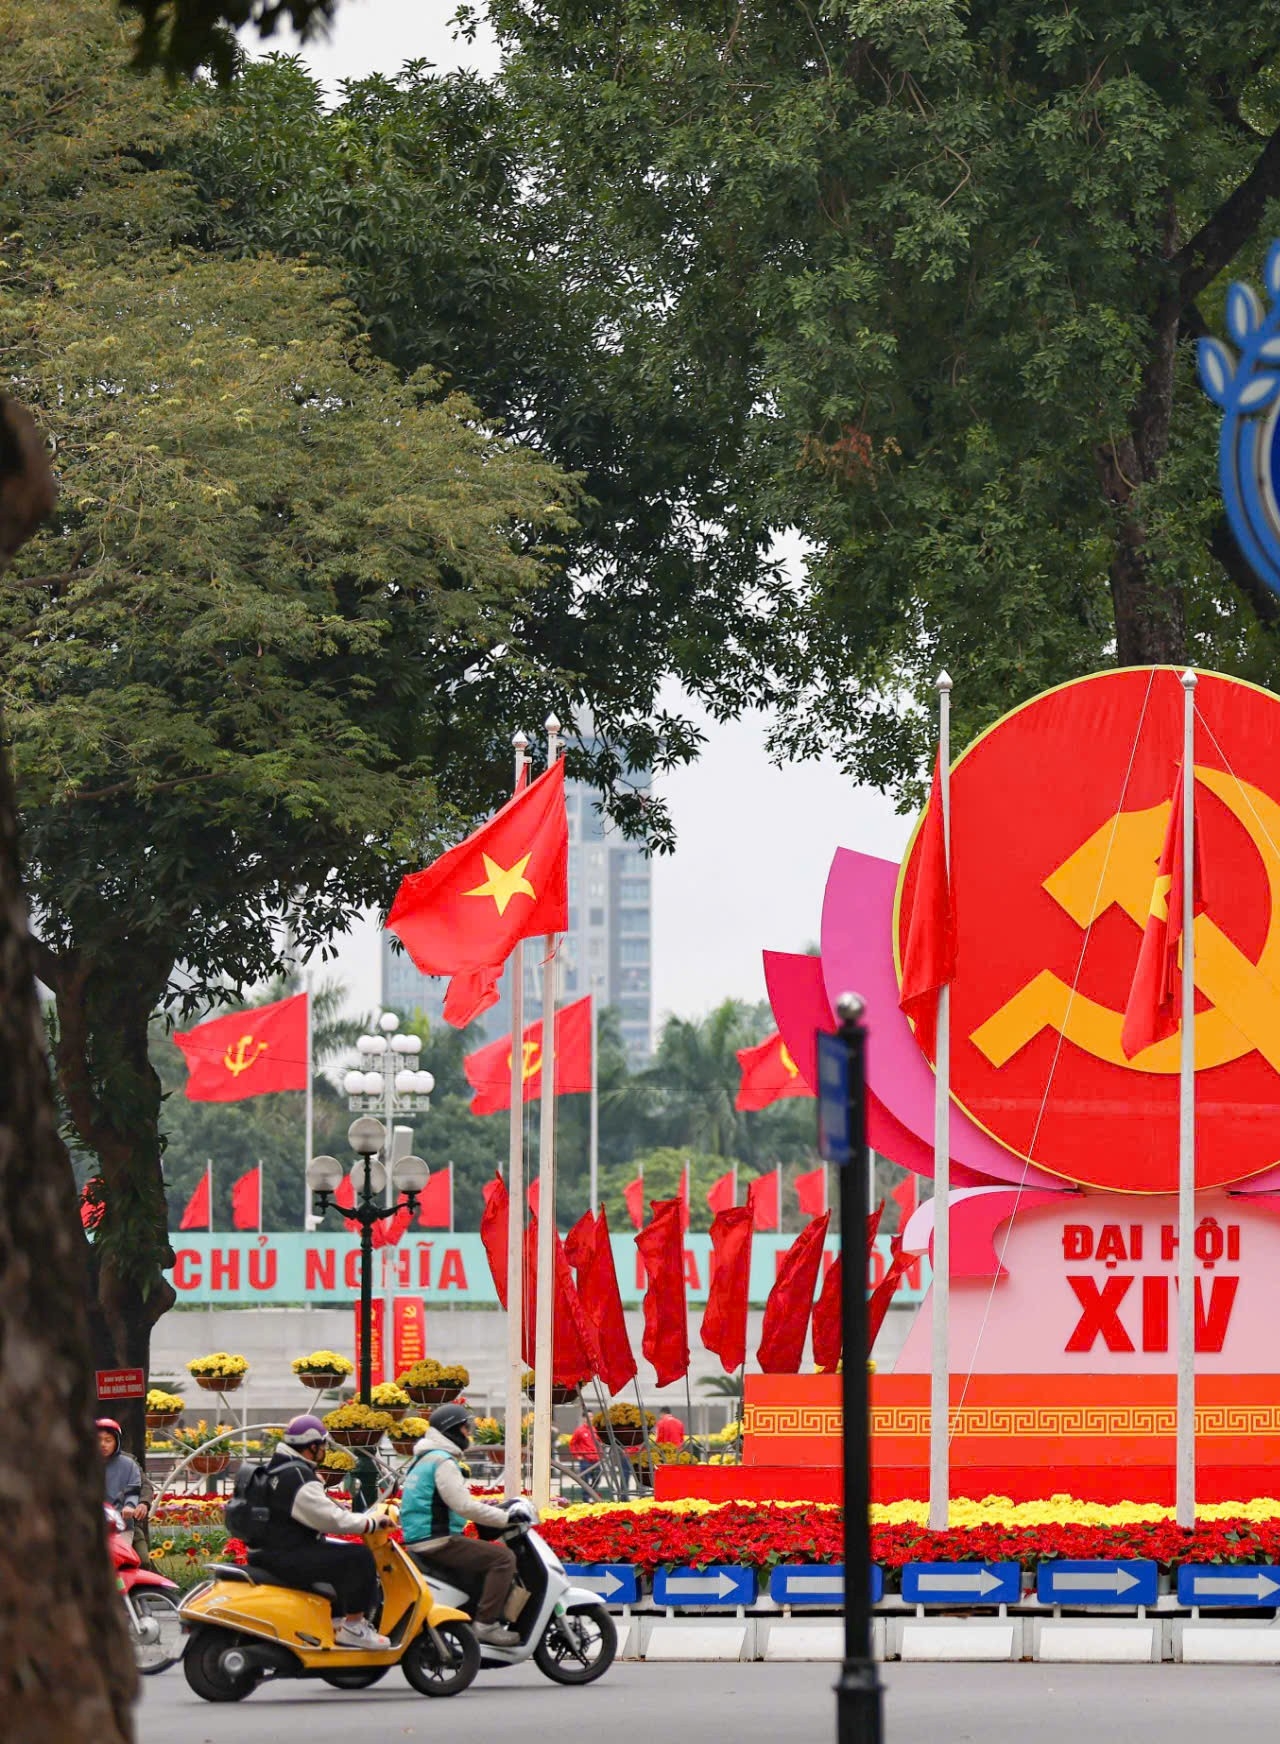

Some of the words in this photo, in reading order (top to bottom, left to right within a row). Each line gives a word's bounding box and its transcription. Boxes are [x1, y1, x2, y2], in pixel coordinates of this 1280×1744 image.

[172, 1236, 278, 1290] CHỦ
[1062, 1225, 1142, 1268] ĐẠI
[1161, 1217, 1240, 1268] HỘI
[1064, 1275, 1240, 1352] XIV
